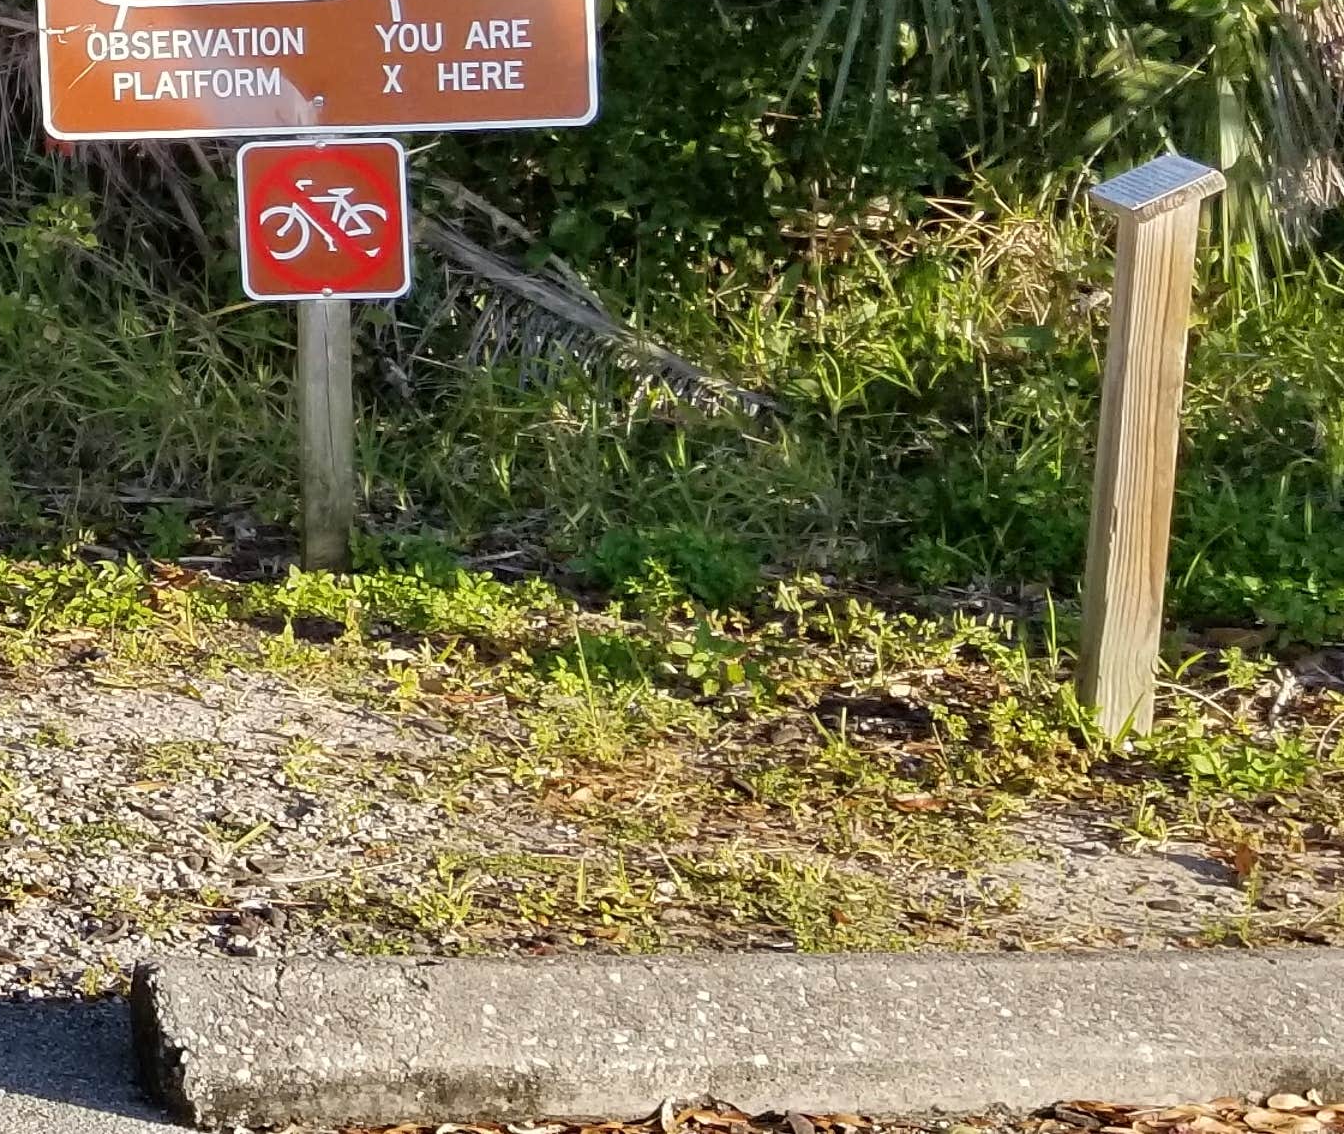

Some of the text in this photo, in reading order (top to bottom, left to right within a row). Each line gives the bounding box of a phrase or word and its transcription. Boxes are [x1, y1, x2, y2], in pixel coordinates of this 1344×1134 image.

[86, 26, 304, 62] OBSERVATION
[376, 19, 532, 54] YOU ARE
[113, 67, 282, 101] PLATFORM
[382, 60, 525, 94] X HERE
